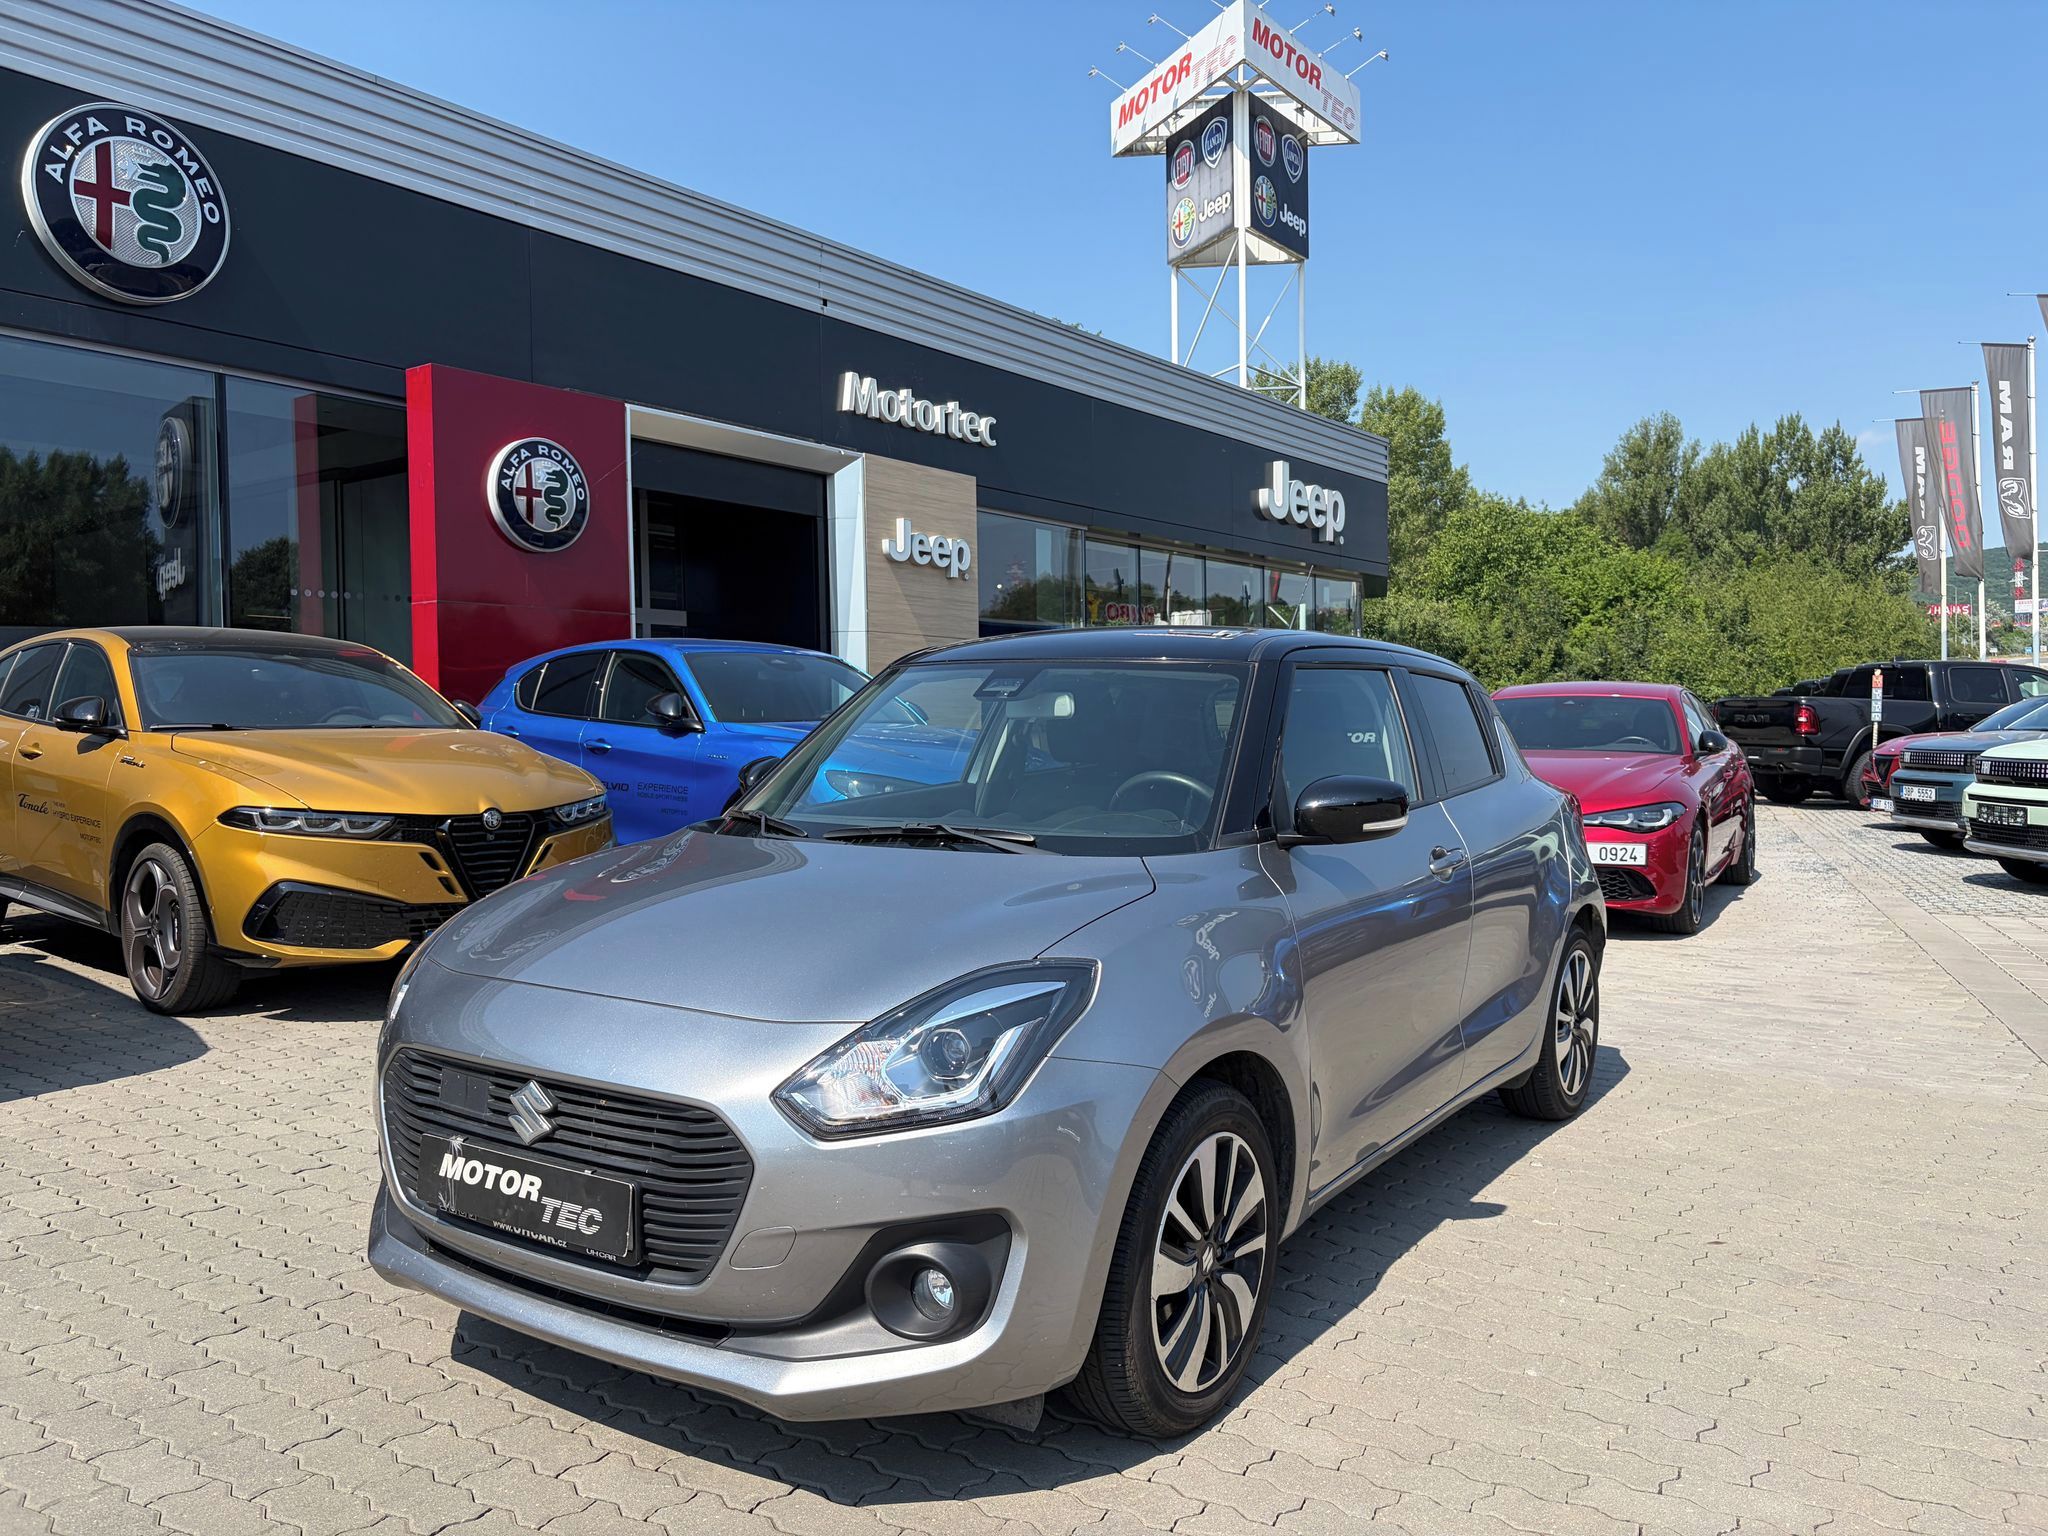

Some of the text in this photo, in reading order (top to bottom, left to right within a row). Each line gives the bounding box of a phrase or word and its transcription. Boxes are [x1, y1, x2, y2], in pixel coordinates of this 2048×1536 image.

[1118, 34, 1237, 129] MOTOR TEC
[1252, 16, 1356, 131] MOTOR TEC
[1259, 128, 1273, 156] FIAT
[45, 116, 220, 224] ALFA ROMEO
[1176, 150, 1191, 179] FIAT
[1198, 191, 1231, 223] Jeep
[1279, 203, 1307, 237] Jeep
[841, 371, 998, 447] Motortec
[501, 445, 585, 501] ALFA ROMEO
[1258, 460, 1346, 545] Jeep
[881, 517, 972, 581] Jeep
[1347, 732, 1376, 744] OR
[17, 793, 49, 815] Tonale
[637, 782, 689, 795] EXPERIENCE
[70, 813, 102, 829] EXPERIENCE
[1599, 846, 1638, 862] 0924
[438, 1152, 603, 1235] MOTOR TEC
